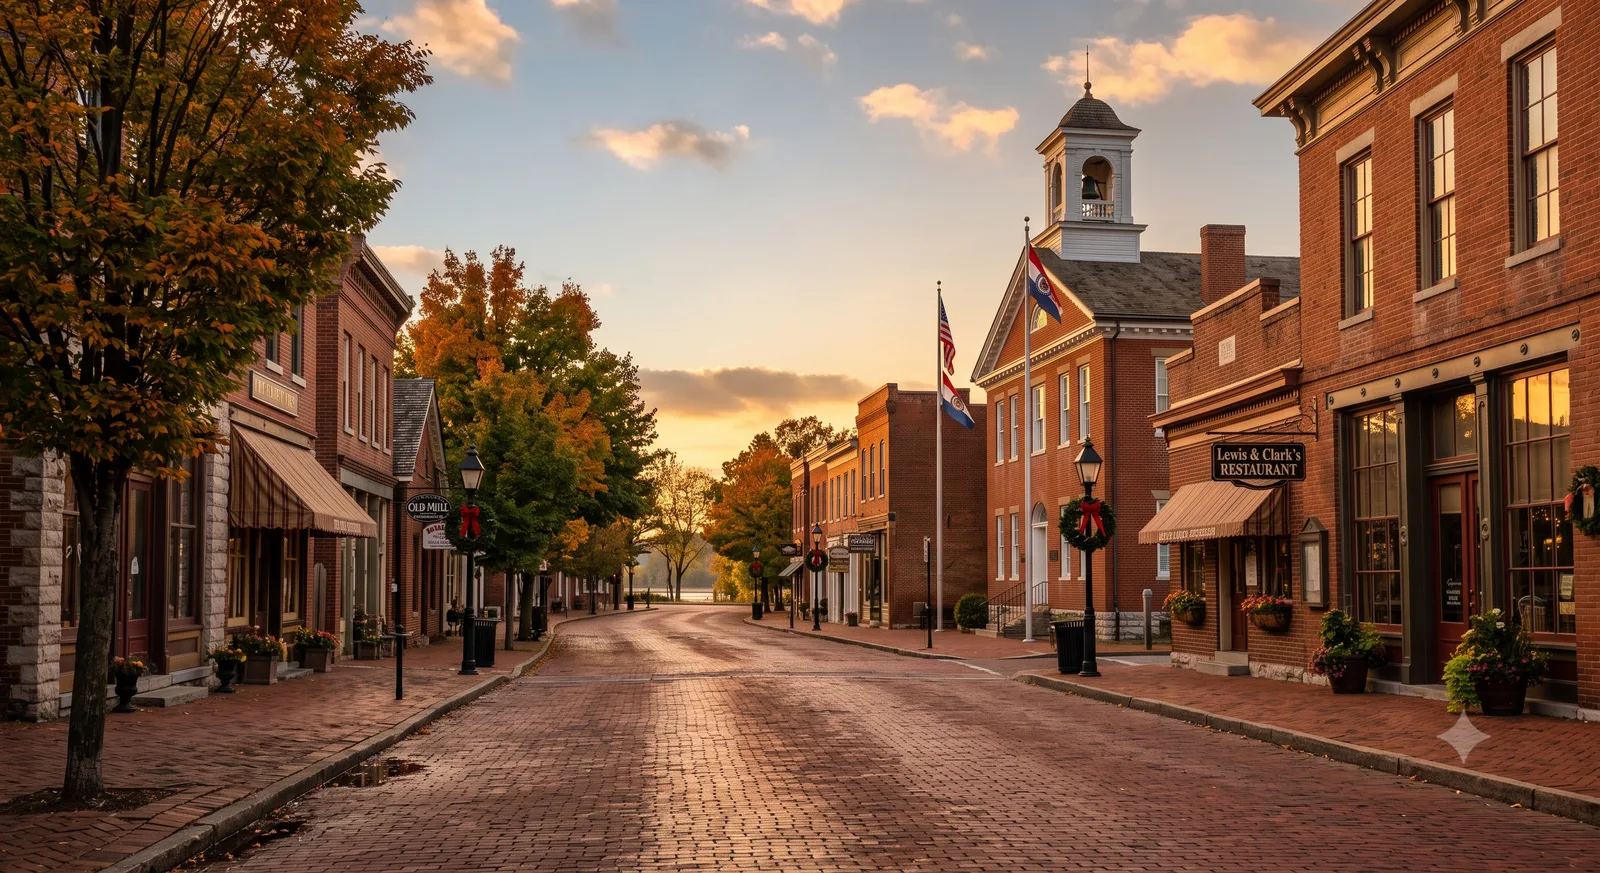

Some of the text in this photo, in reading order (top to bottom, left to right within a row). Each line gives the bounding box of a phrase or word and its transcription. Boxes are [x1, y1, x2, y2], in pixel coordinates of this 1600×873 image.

[1217, 447, 1301, 461] Lewis & Clark's
[1220, 463, 1297, 476] RESTAURANT
[408, 502, 426, 512] OLD
